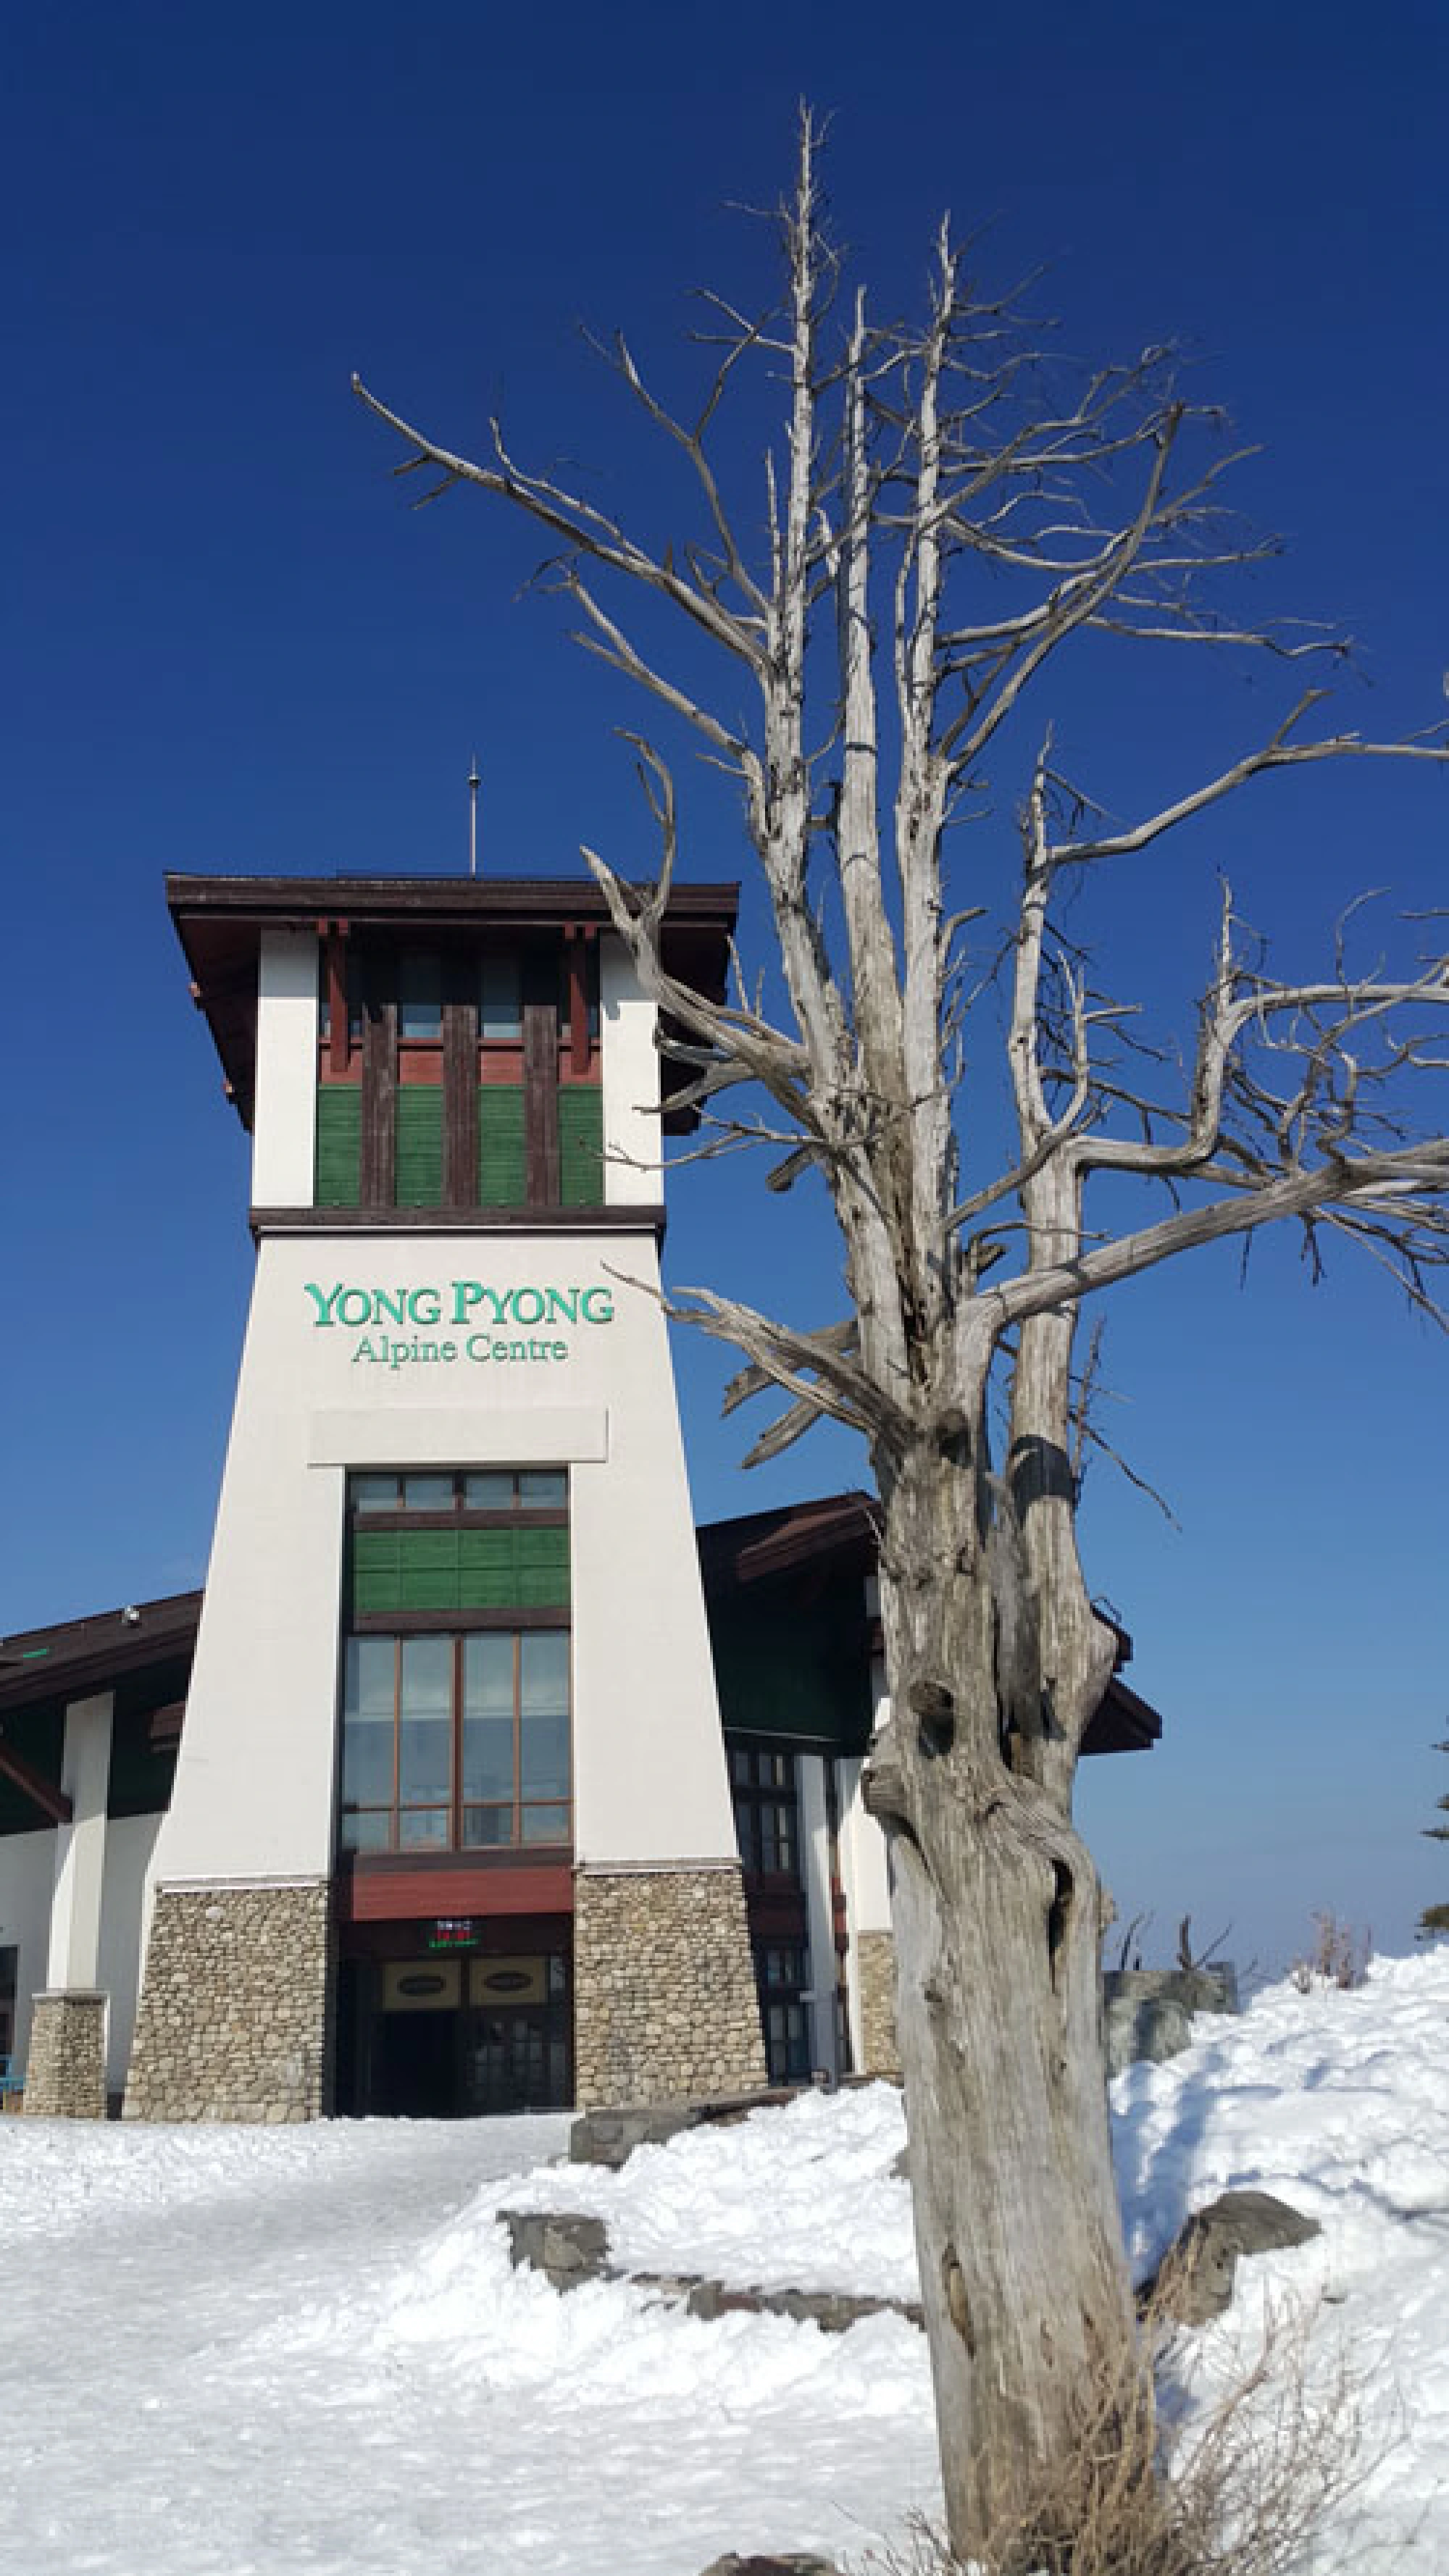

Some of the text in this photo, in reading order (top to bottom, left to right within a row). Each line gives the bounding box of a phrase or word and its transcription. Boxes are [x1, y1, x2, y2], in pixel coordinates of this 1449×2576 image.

[304, 1280, 614, 1326] YONG PYONG
[351, 1334, 569, 1370] Alpine Centre
